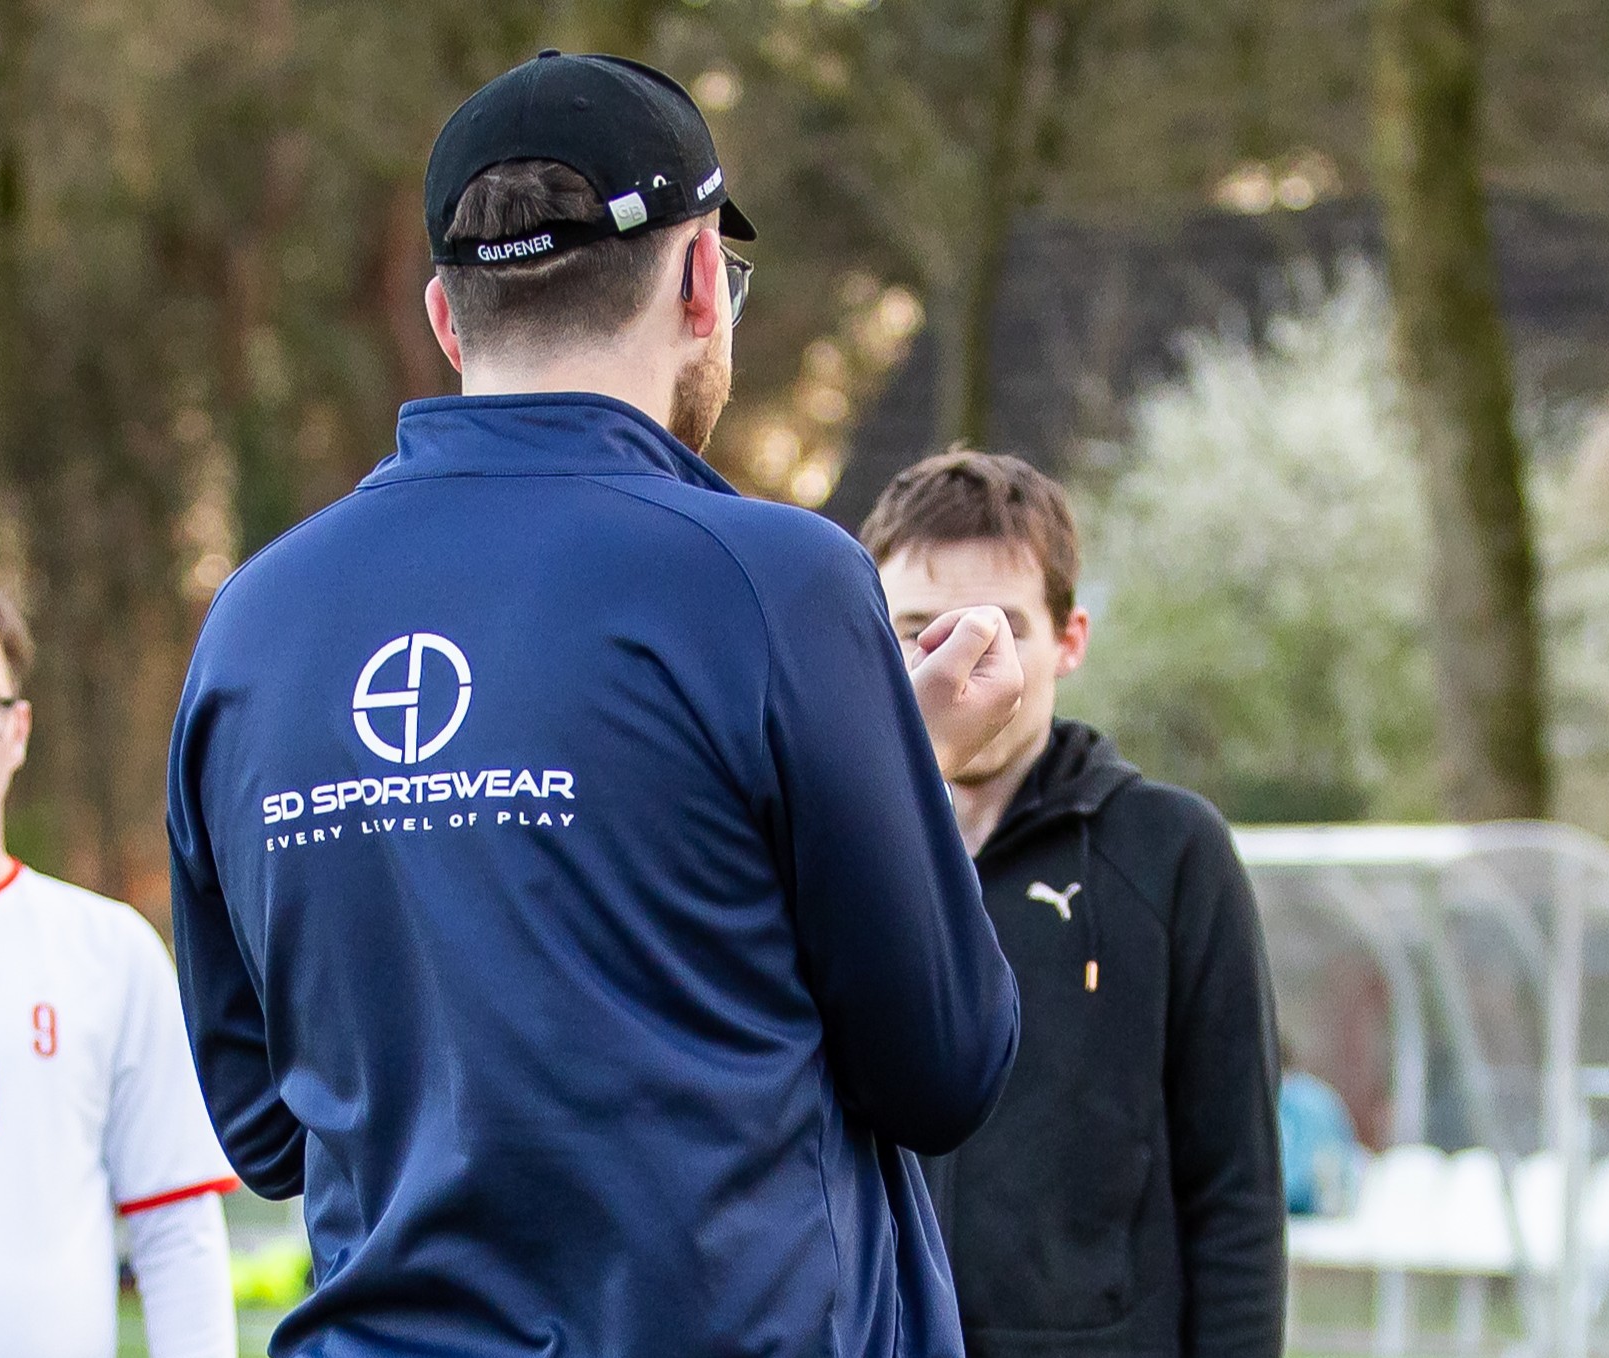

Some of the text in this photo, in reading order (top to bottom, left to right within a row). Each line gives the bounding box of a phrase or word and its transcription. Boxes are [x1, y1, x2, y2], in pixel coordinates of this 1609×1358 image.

[477, 233, 554, 261] GULPENER
[262, 768, 576, 825] SD SPORTSWEAR
[266, 824, 343, 852] EVERY
[449, 812, 478, 828] OF
[496, 811, 575, 827] PLAY
[32, 1002, 57, 1058] 9
